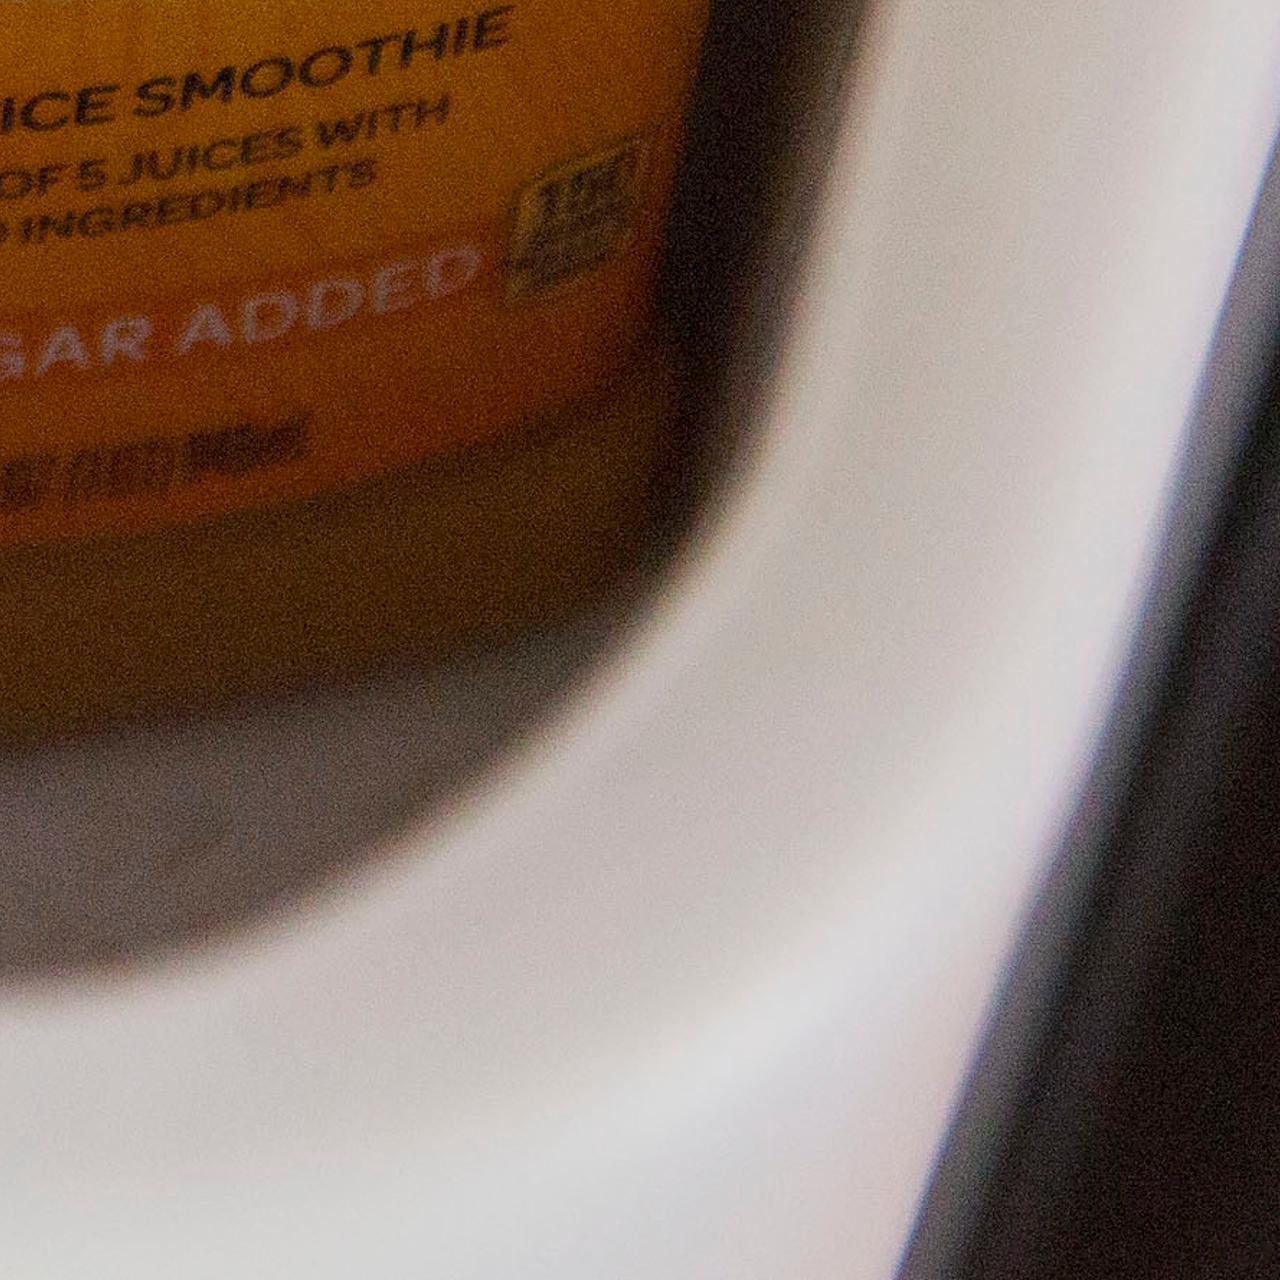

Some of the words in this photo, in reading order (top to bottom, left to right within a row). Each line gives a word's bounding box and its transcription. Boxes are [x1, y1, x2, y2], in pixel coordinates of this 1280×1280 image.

[132, 4, 516, 119] SMOOTHIE
[76, 157, 107, 192] 5
[118, 124, 305, 188] JUICES
[315, 94, 451, 148] WITH
[19, 157, 379, 243] INGREDIENTS
[175, 243, 484, 356] ADDED
